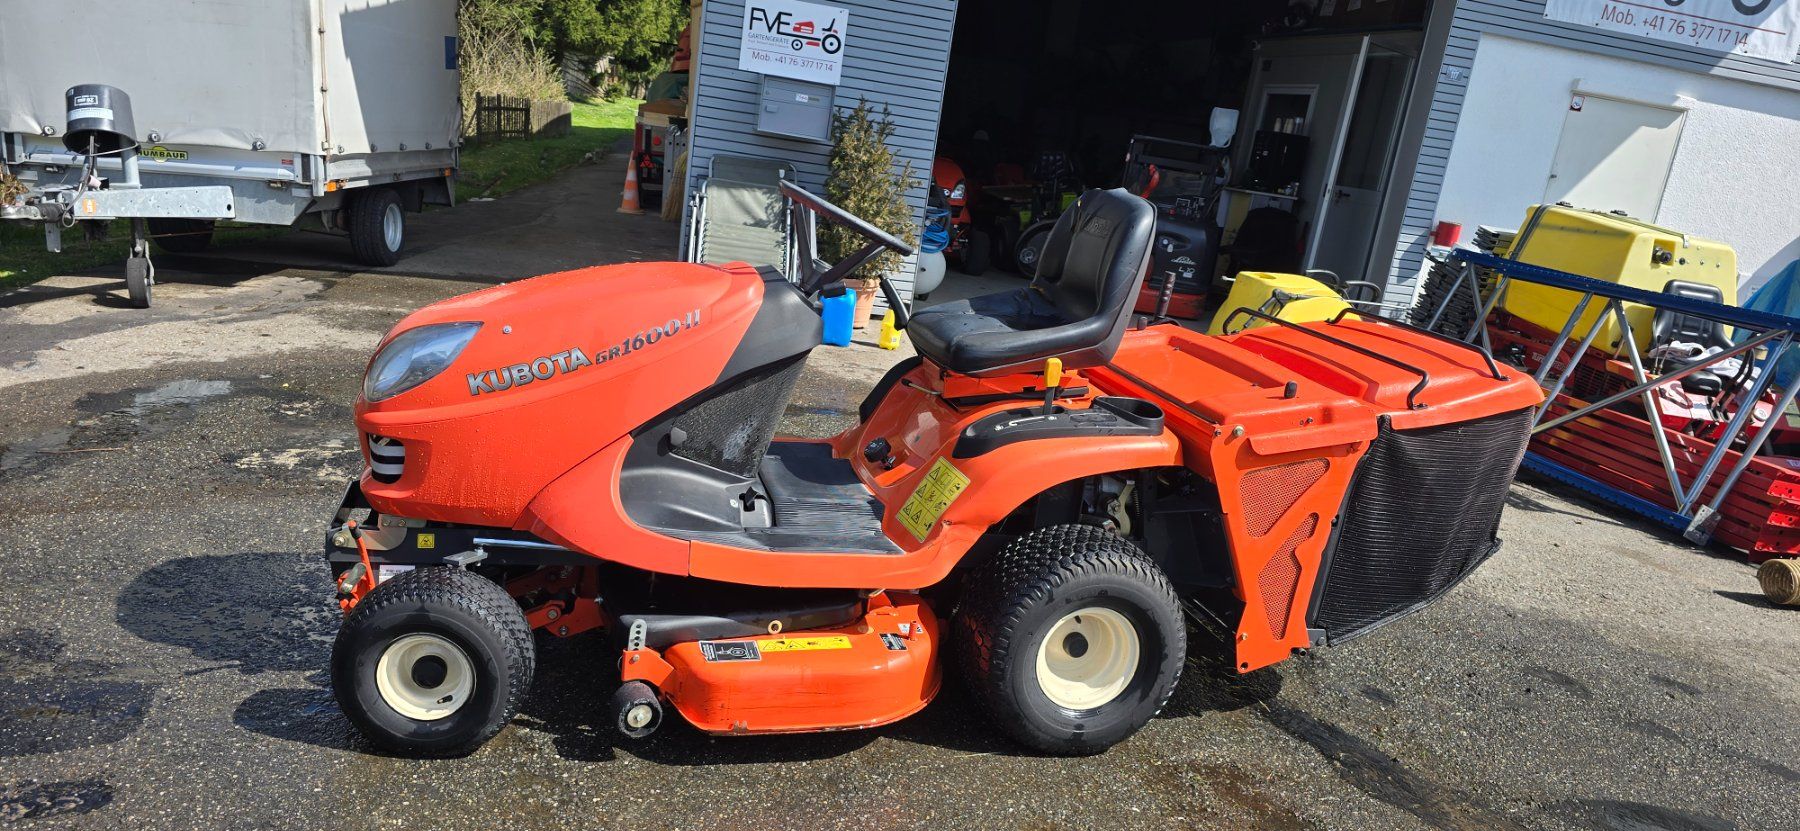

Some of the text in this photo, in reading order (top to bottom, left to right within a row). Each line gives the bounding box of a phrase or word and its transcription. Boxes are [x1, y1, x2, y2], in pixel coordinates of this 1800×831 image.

[749, 7, 793, 34] FVE
[1601, 4, 1749, 47] Mob. +41 76 377 17 14
[751, 51, 833, 72] Mob. +41 76 377 17 14
[466, 347, 592, 396] KUBOTA
